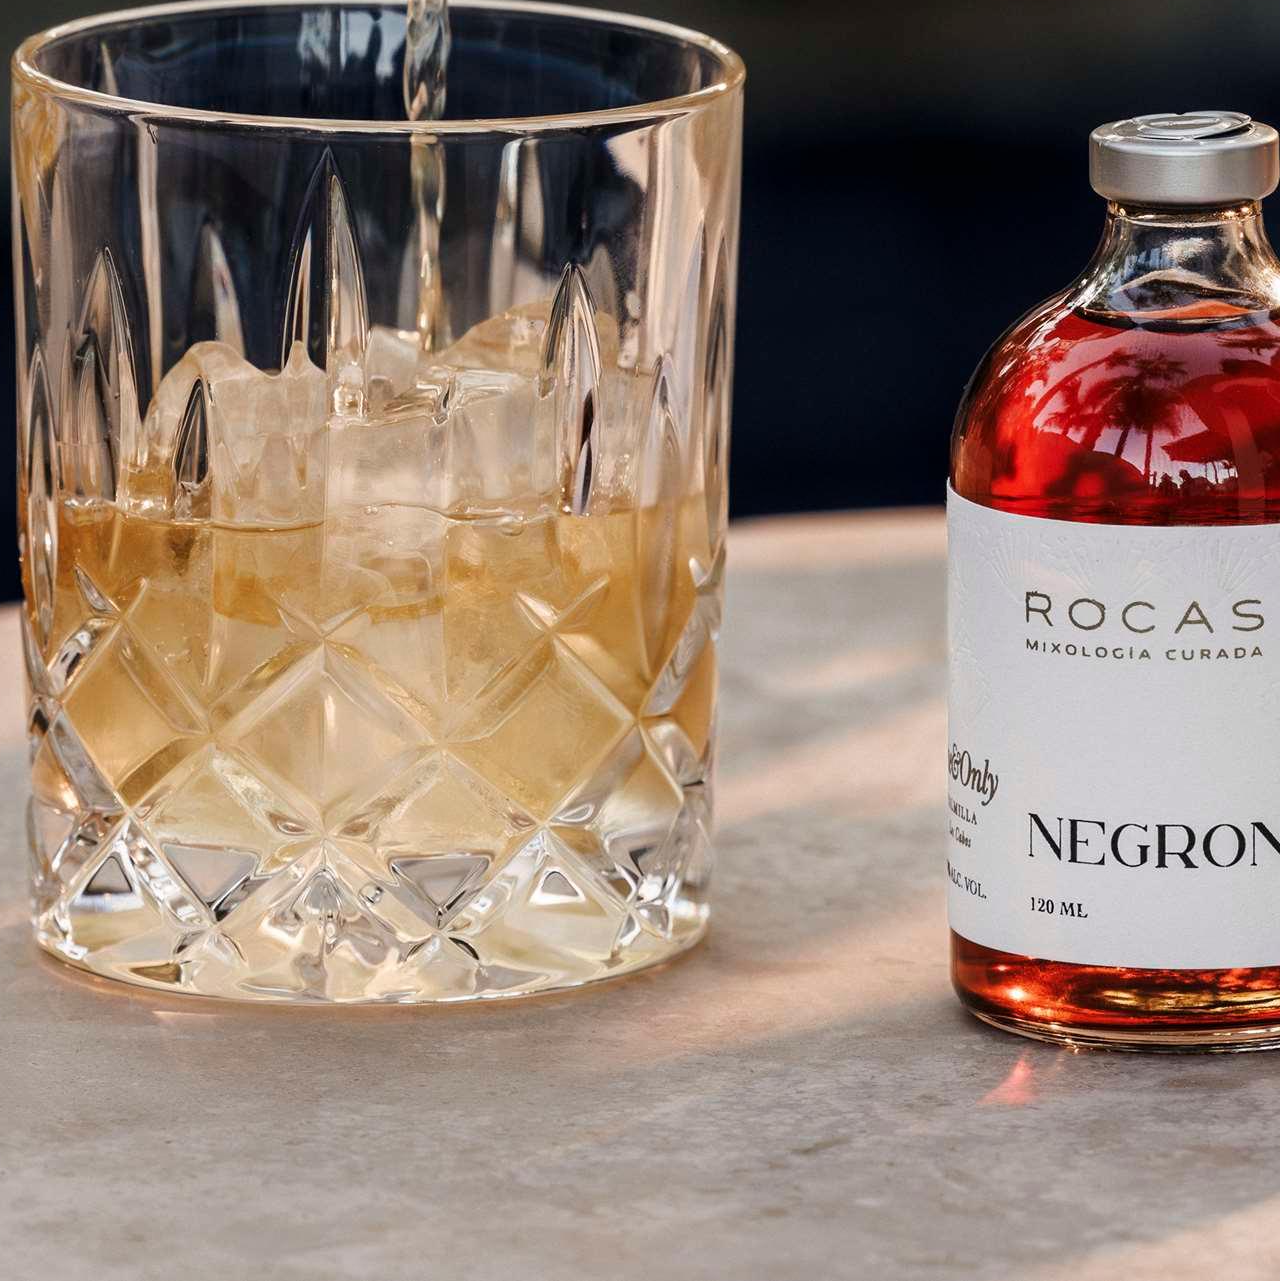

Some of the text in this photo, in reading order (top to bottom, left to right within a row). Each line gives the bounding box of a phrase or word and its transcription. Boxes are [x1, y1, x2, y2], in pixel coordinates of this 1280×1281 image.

[1025, 590, 1265, 634] ROCAS
[1026, 638, 1263, 661] MIXOLOGÍA CURADA
[964, 876, 988, 899] VOL.
[1030, 897, 1088, 918] 120 ML
